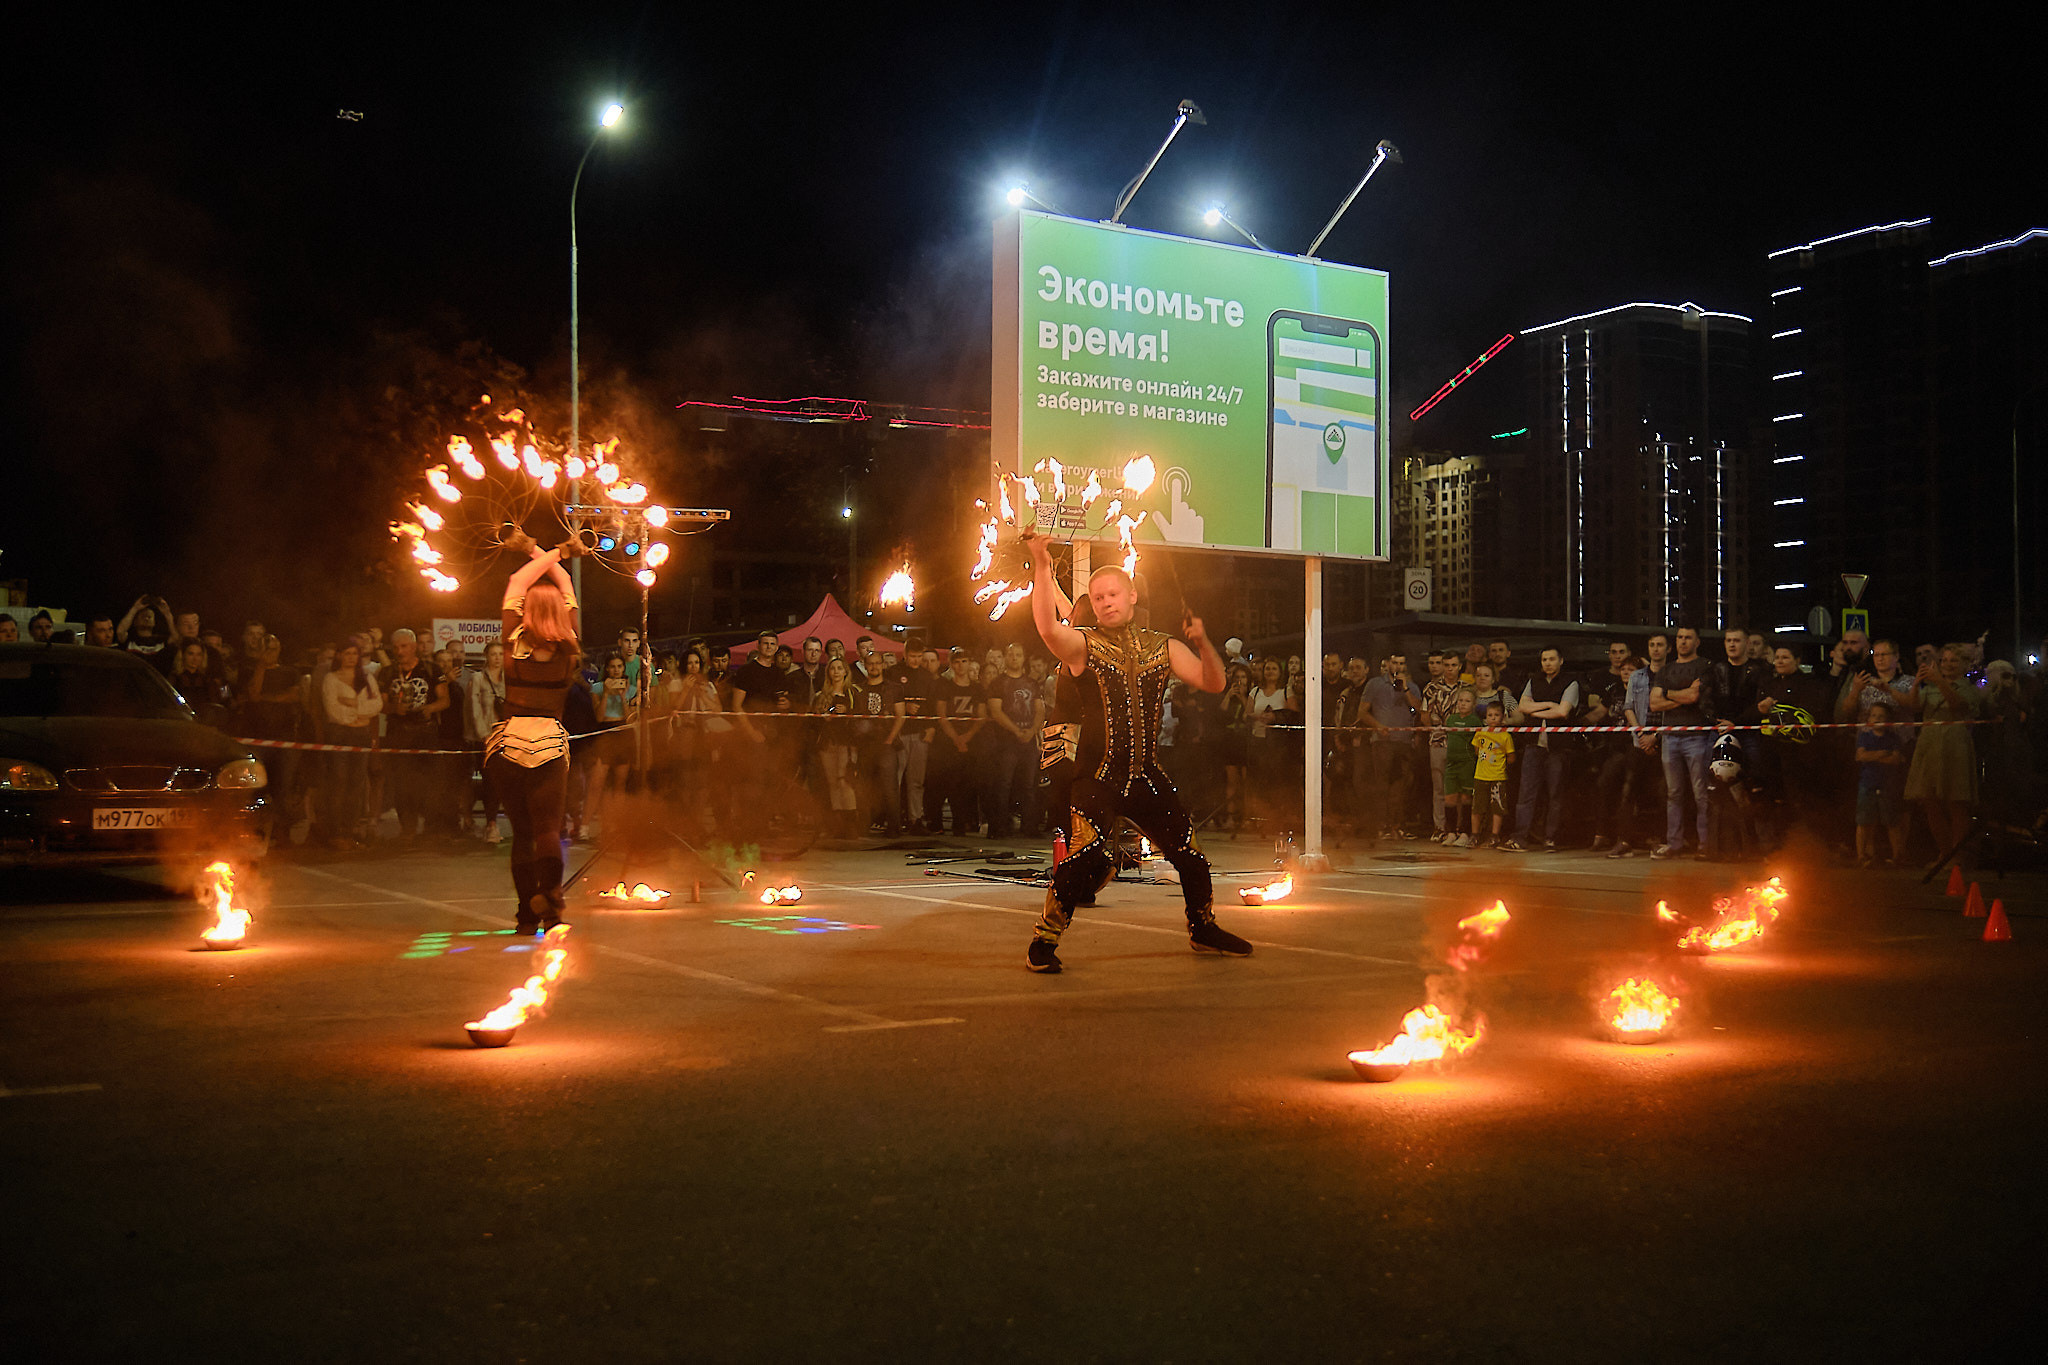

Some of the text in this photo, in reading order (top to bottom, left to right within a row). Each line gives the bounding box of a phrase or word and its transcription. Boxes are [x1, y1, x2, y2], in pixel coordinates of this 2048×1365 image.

[1037, 265, 1245, 328] Экономьте
[1037, 320, 1169, 363] время!
[1037, 364, 1244, 405] Закажите онлайн 24/7
[1037, 391, 1228, 427] заберите в магазине
[1048, 483, 1056, 493] в
[1413, 585, 1424, 594] 20
[458, 623, 502, 633] МОБИЛЬН
[954, 696, 974, 713] Z
[98, 810, 165, 827] М977ОК
